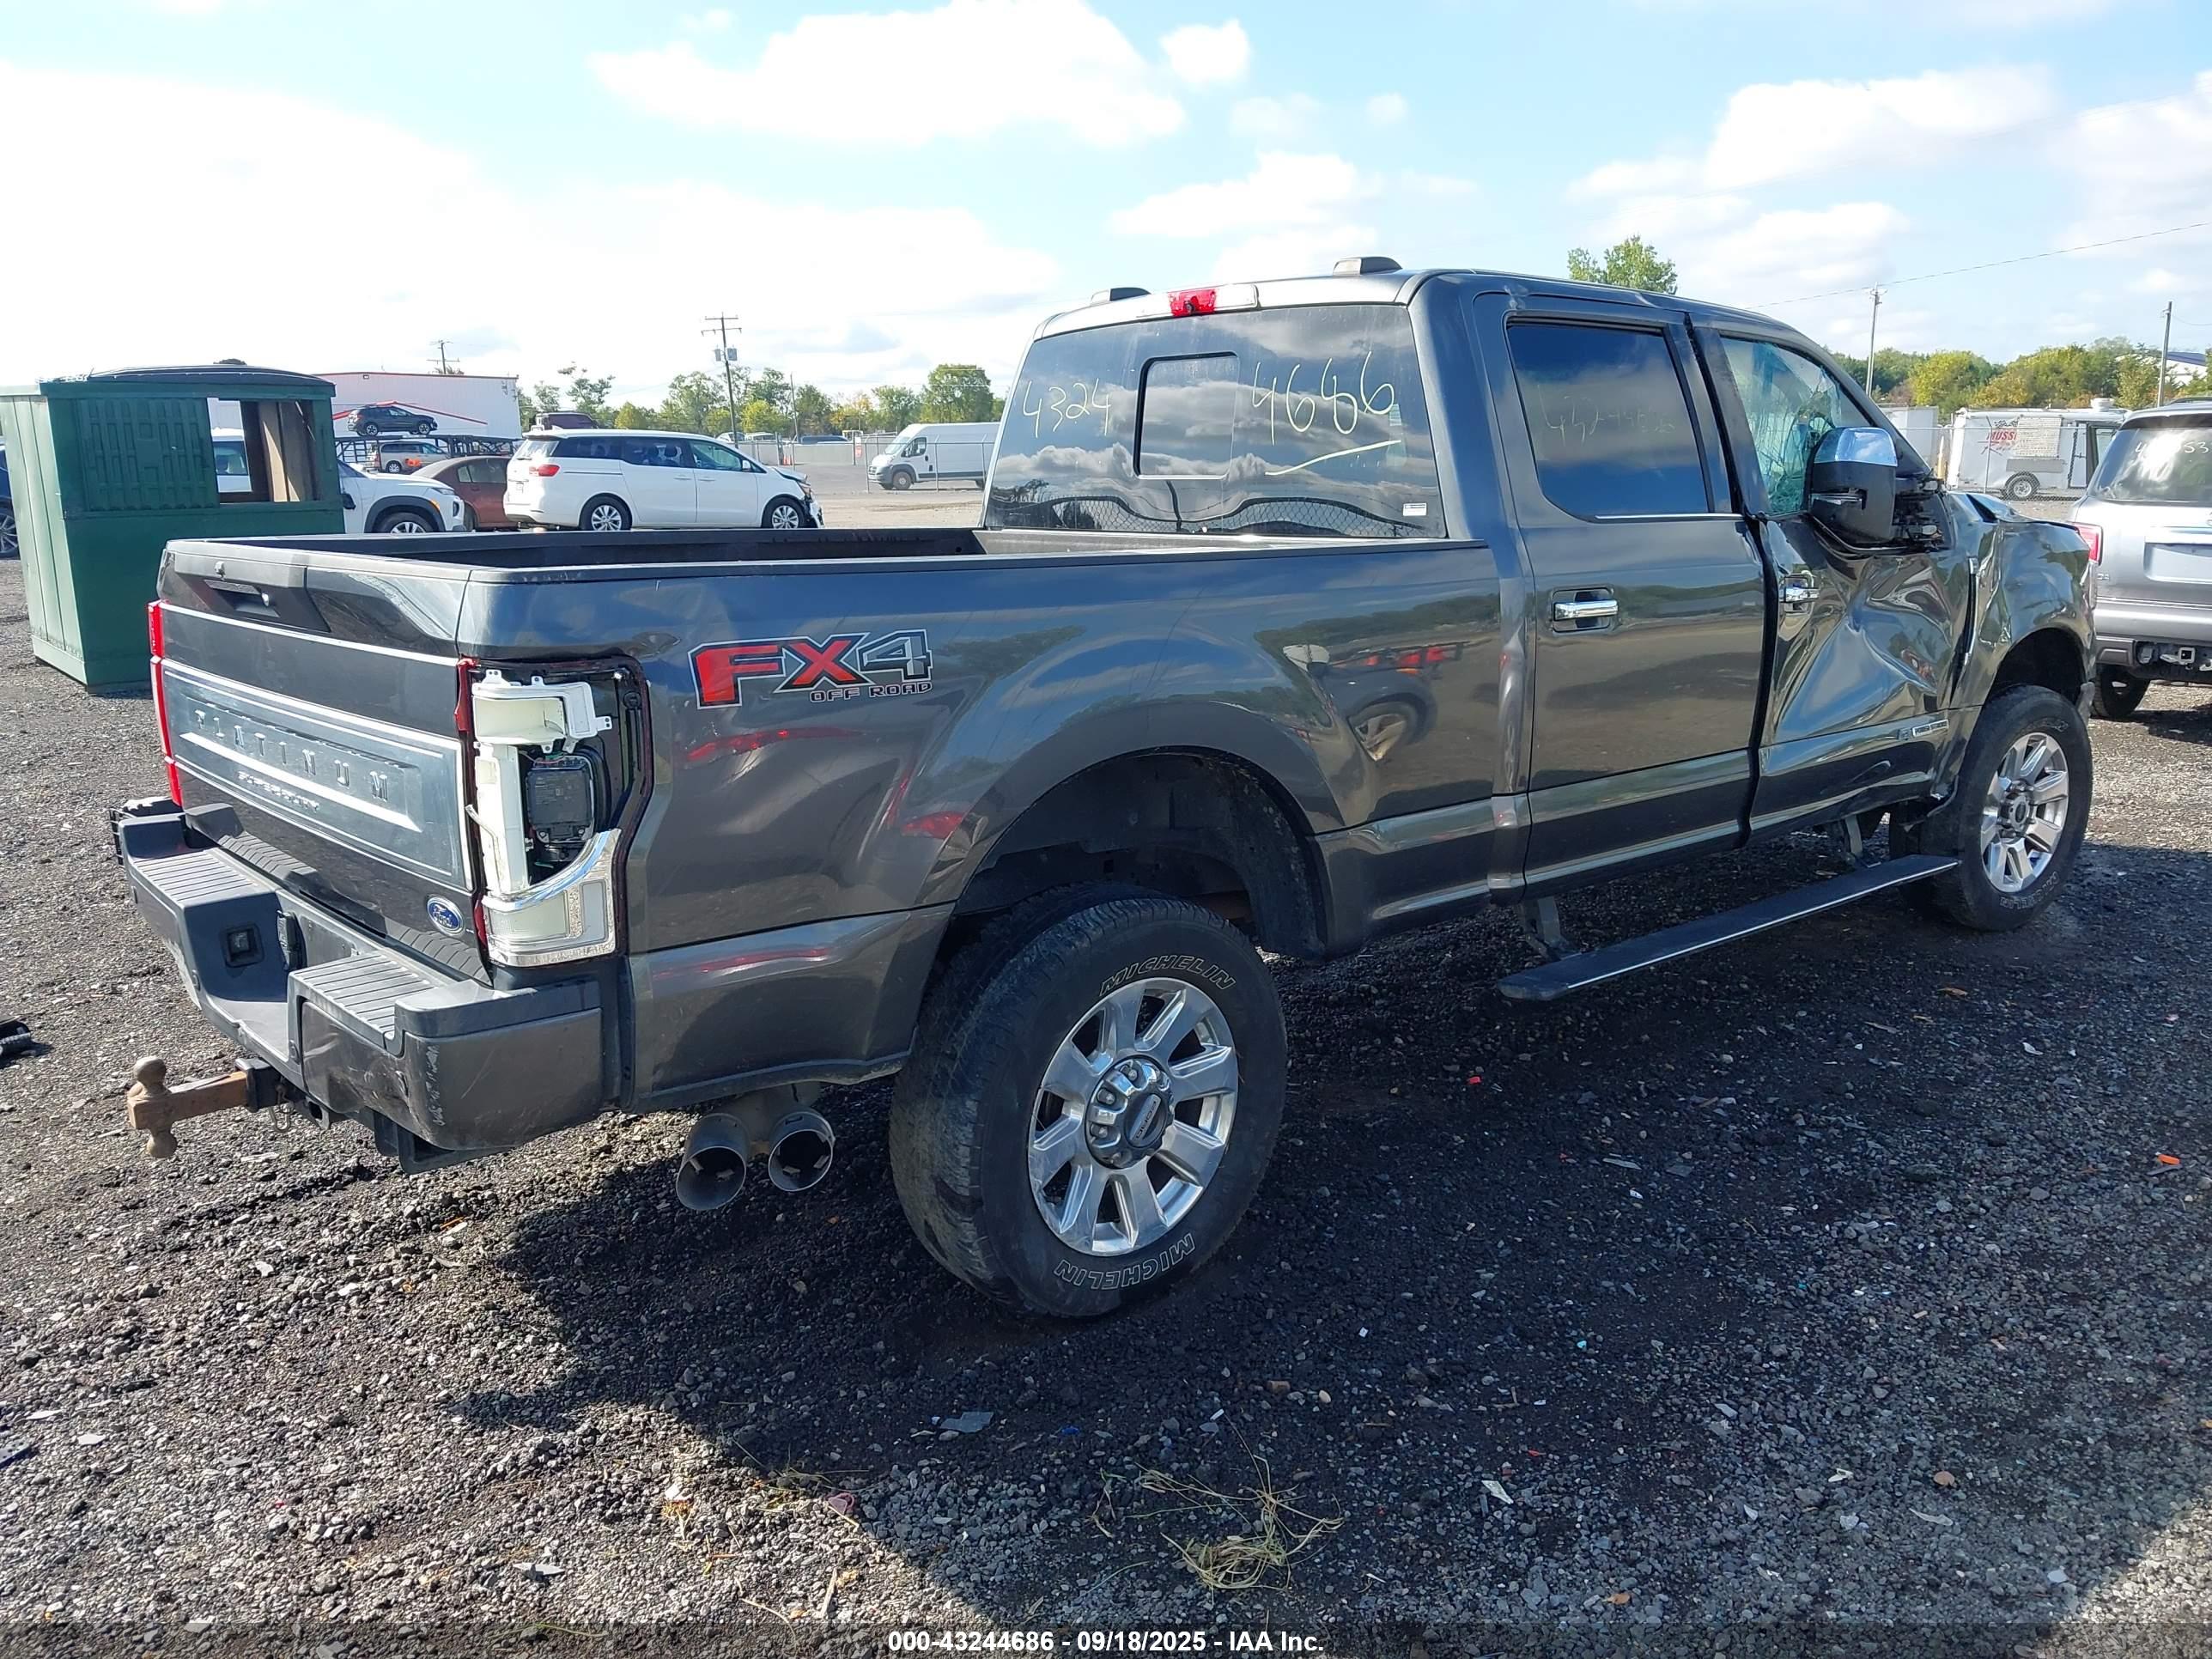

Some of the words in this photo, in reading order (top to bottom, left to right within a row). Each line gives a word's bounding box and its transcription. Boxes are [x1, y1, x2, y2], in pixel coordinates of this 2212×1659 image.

[1022, 378, 1111, 439] 4324
[687, 629, 934, 709] FX4
[810, 688, 860, 703] OFF
[868, 682, 933, 698] ROAD
[193, 708, 389, 802] PLATINUM
[1097, 954, 1237, 998] MICHELIN
[1053, 1232, 1197, 1291] MICHELIN
